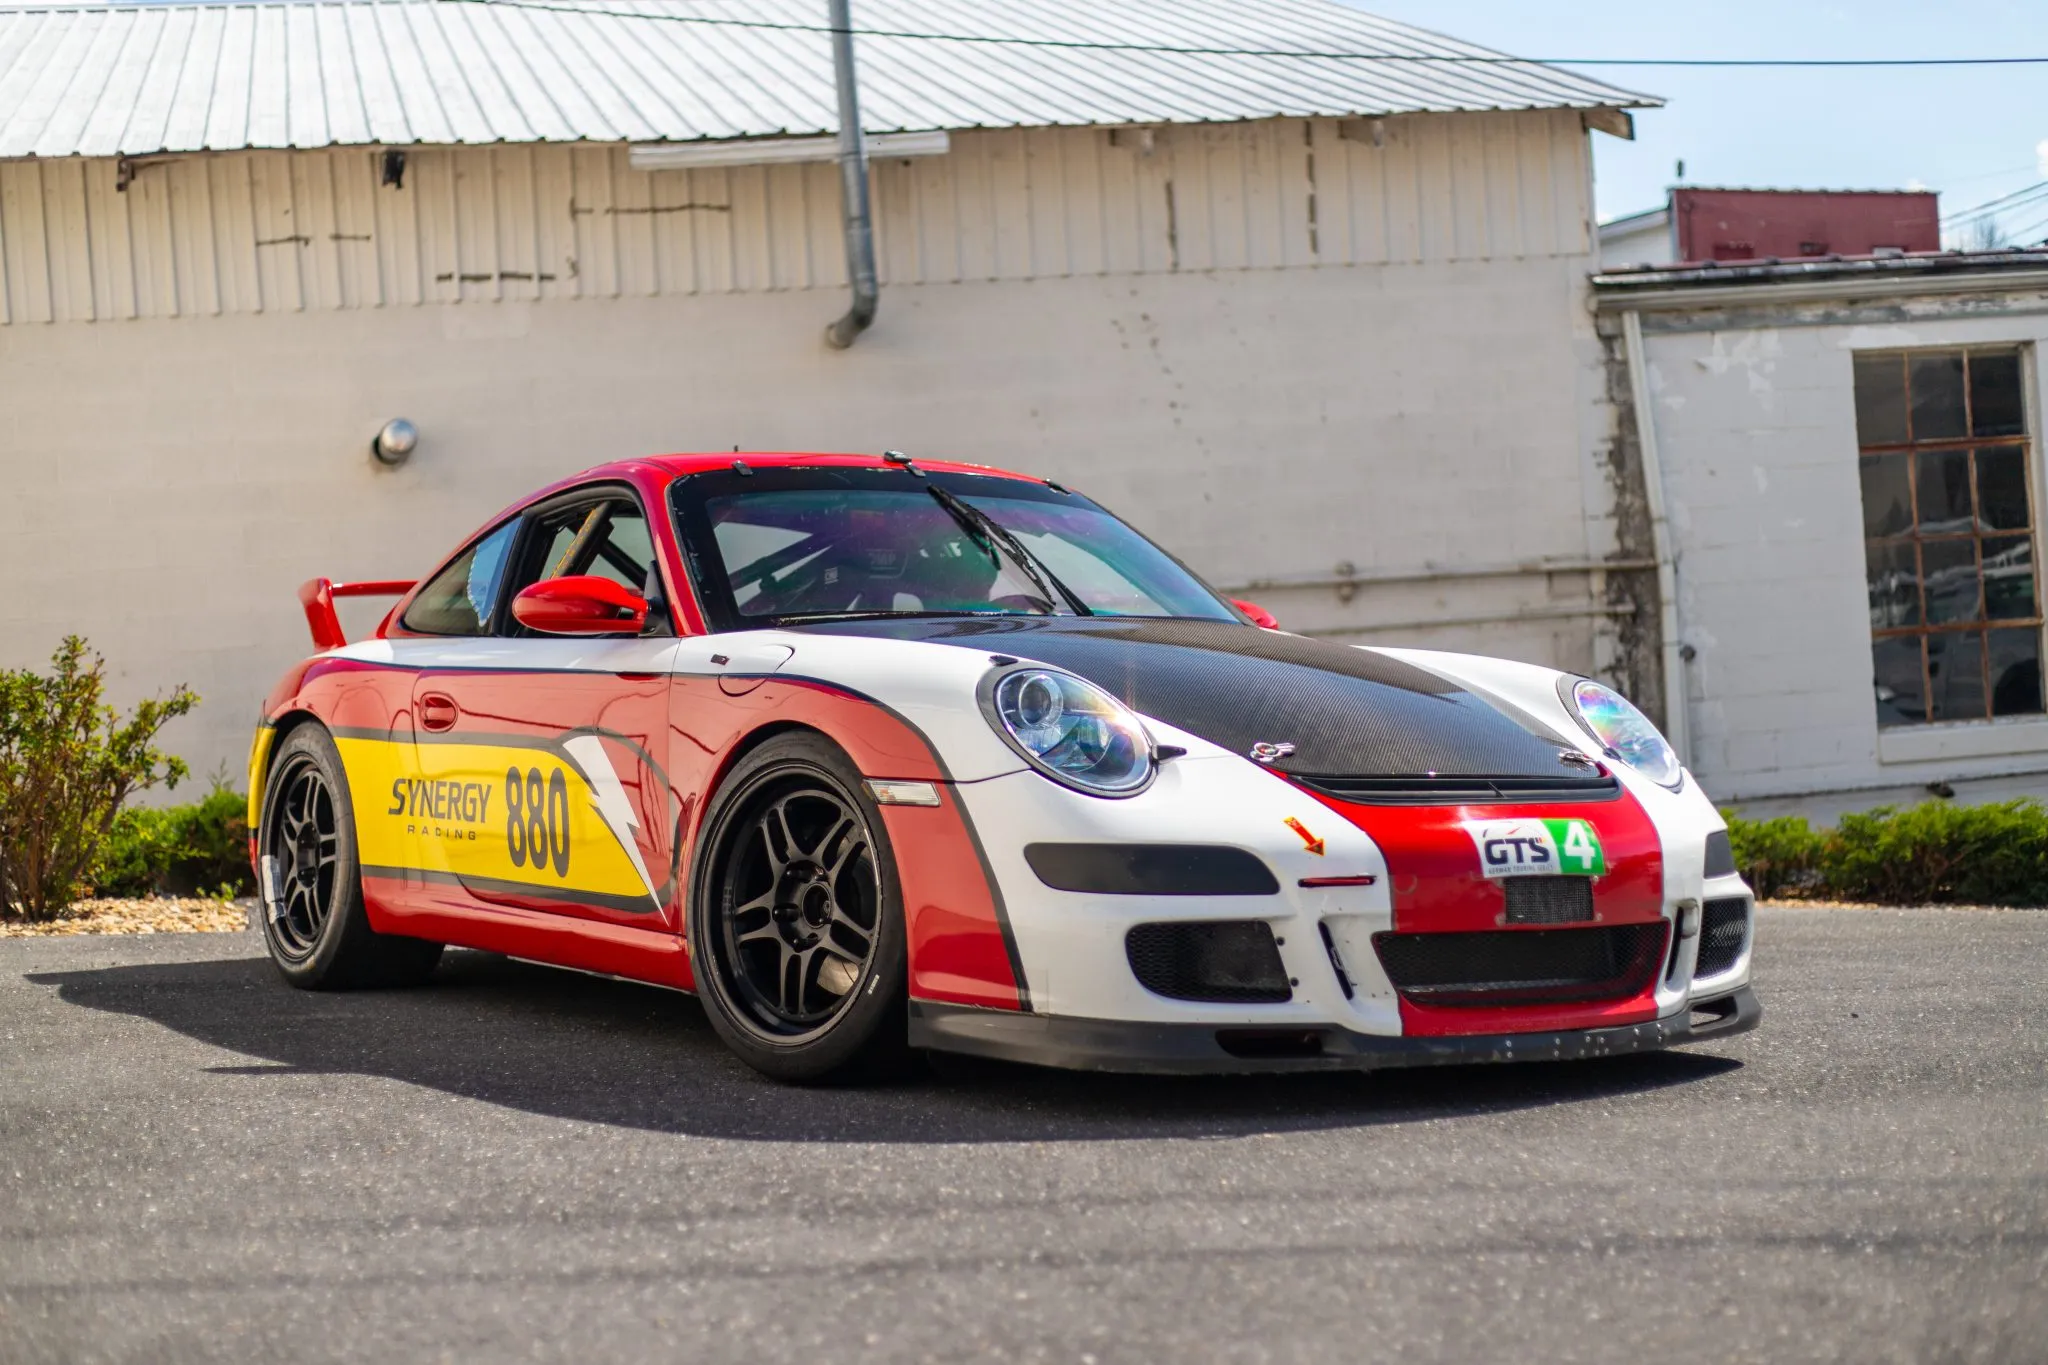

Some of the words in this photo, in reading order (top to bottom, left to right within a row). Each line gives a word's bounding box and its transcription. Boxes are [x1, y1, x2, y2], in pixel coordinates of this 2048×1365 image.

[388, 778, 492, 823] SYNERGY
[506, 766, 570, 878] 880
[407, 824, 477, 841] RACING
[1484, 837, 1550, 865] GTS
[1564, 821, 1596, 869] 4
